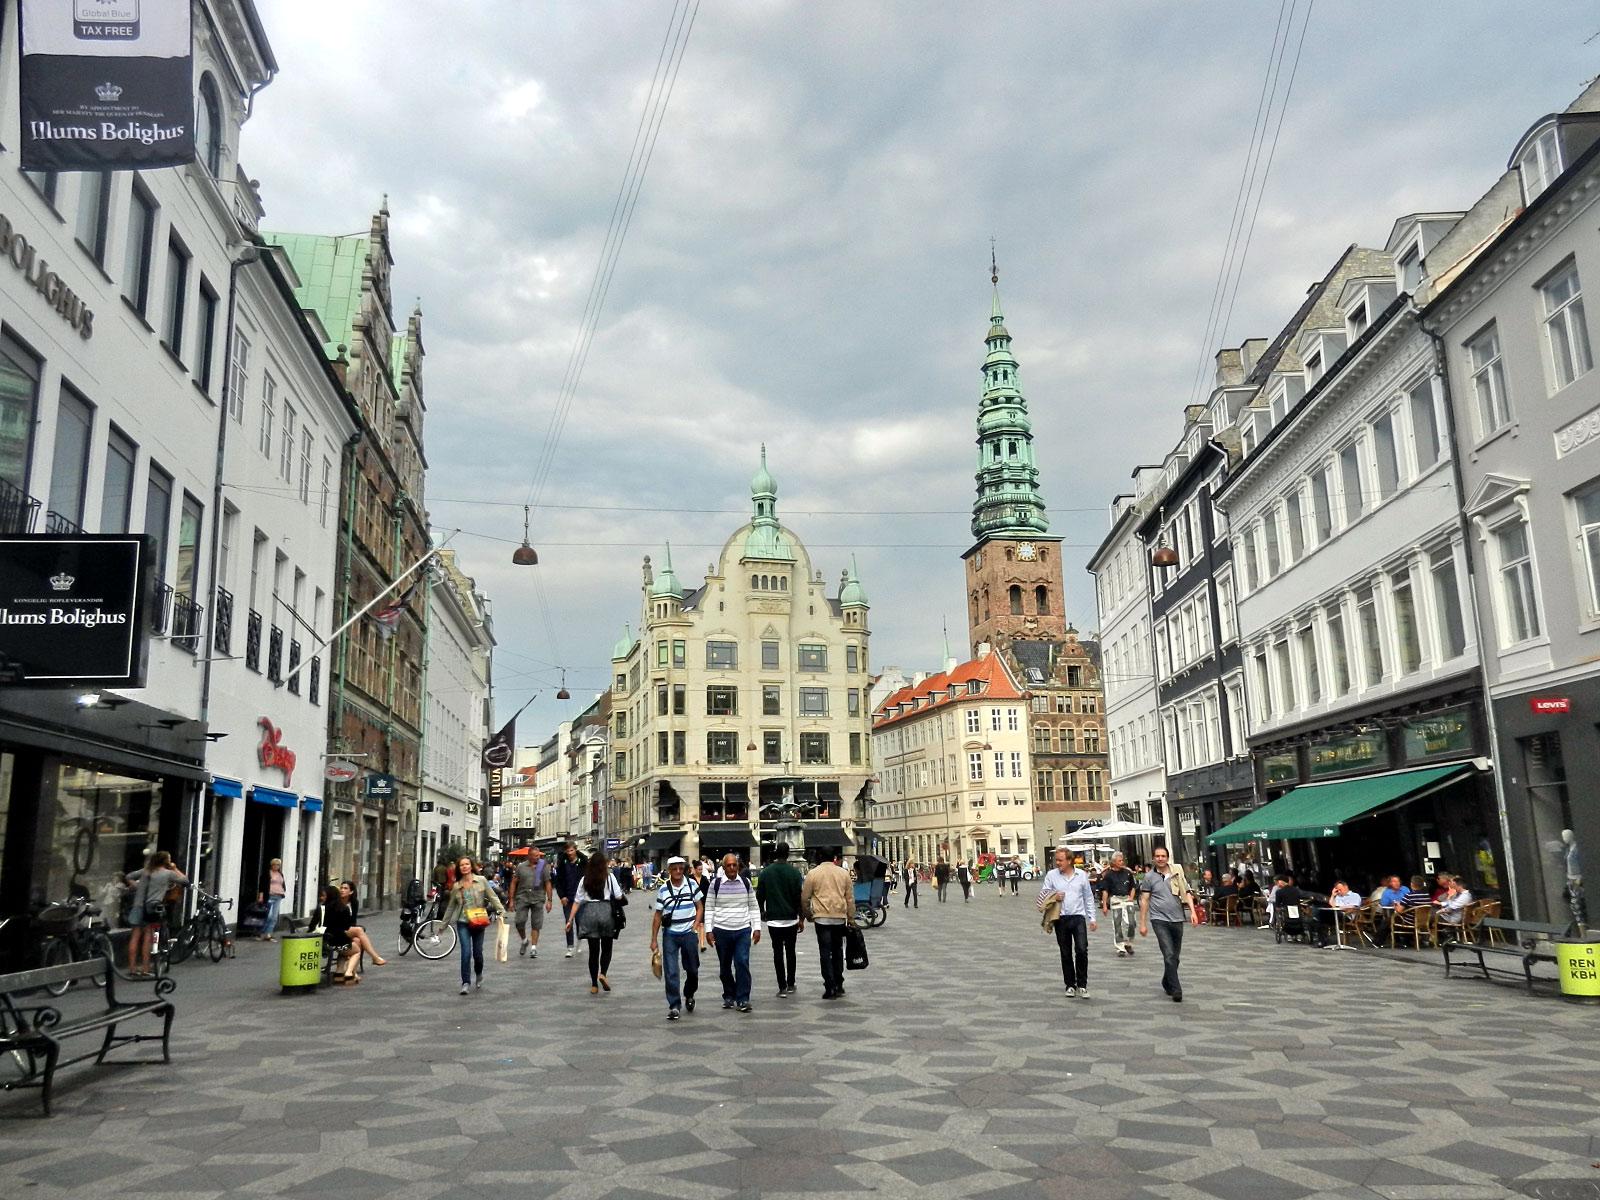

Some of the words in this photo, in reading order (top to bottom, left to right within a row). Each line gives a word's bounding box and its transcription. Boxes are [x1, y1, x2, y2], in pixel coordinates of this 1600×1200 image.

[82, 9, 110, 18] Global
[111, 10, 132, 18] Blue
[80, 25, 102, 36] TAX
[105, 26, 133, 36] FREE
[30, 121, 97, 140] Illums
[101, 122, 185, 145] Bolighus
[50, 607, 127, 628] Bolighus
[300, 952, 319, 960] REN
[300, 962, 318, 970] KBH
[1569, 959, 1595, 967] REN
[1571, 971, 1597, 979] KBH
